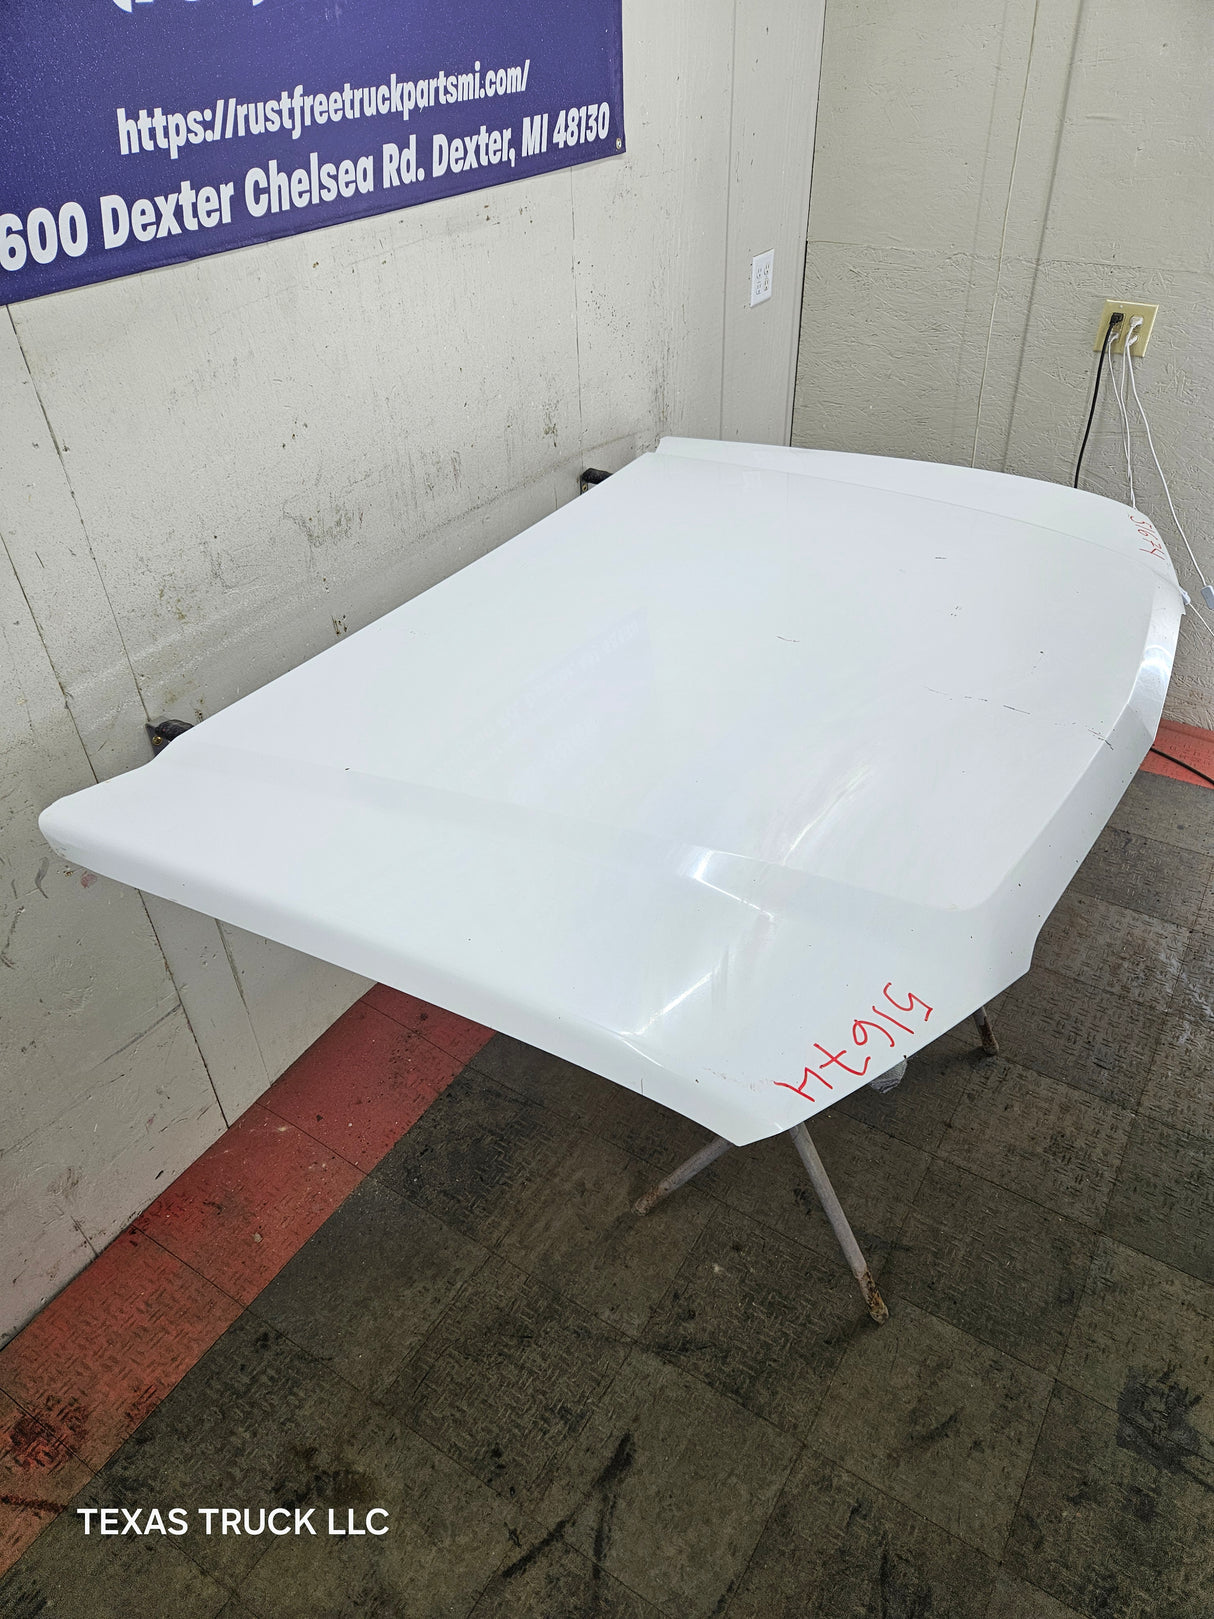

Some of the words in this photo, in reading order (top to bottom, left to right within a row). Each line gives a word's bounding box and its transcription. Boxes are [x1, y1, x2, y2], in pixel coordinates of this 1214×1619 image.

[117, 60, 530, 160] https://rustfreetruckpartsmi.com/
[0, 201, 89, 272] 600
[99, 180, 235, 250] Dexter
[244, 152, 374, 218] Chelsea
[382, 134, 425, 188] Rd.
[432, 125, 516, 178] Dexter,
[521, 114, 549, 157] MI
[553, 101, 611, 149] 48130
[1129, 515, 1166, 560] 51674
[773, 982, 933, 1102] 51674
